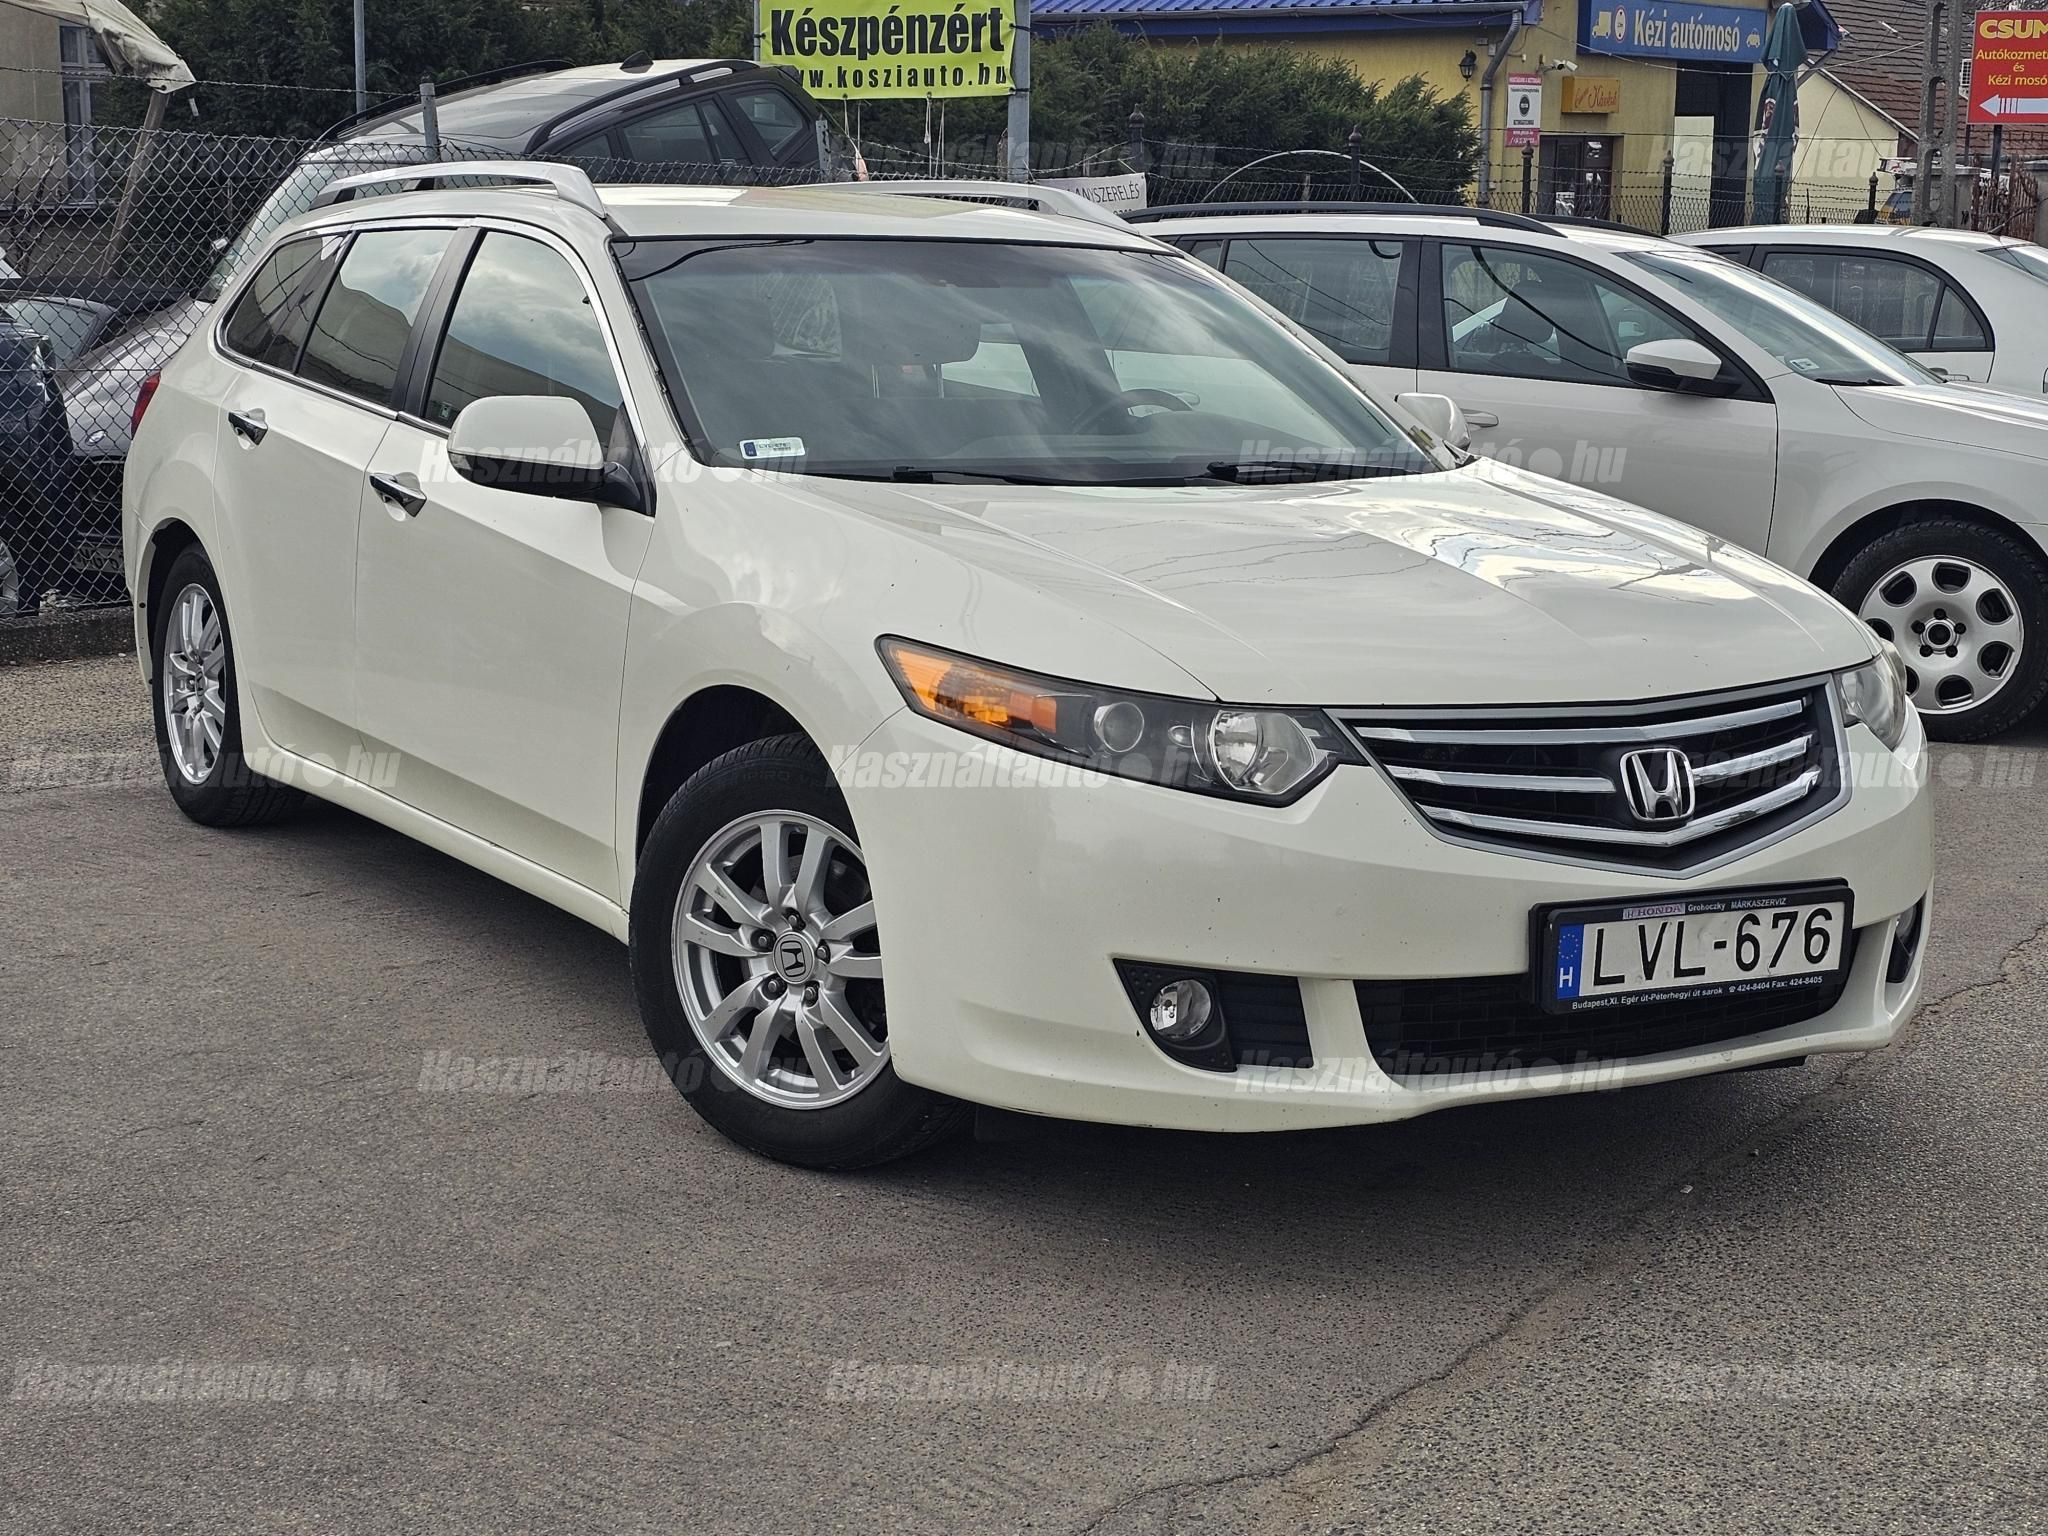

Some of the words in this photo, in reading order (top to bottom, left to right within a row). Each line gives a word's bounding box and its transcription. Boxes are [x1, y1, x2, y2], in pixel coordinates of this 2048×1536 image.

[771, 3, 1004, 60] Készpénzért
[1634, 8, 1667, 47] Kézi
[1670, 13, 1740, 53] autómosó
[2013, 62, 2025, 72] és
[1988, 74, 2011, 85] Kézi
[2015, 74, 2048, 86] mosó
[1638, 904, 1682, 916] HONDA
[1559, 967, 1573, 988] H
[1593, 906, 1833, 987] LVL-676
[1702, 987, 1723, 996] sarok
[1737, 981, 1770, 992] 424-8404
[1771, 980, 1787, 989] Fax:
